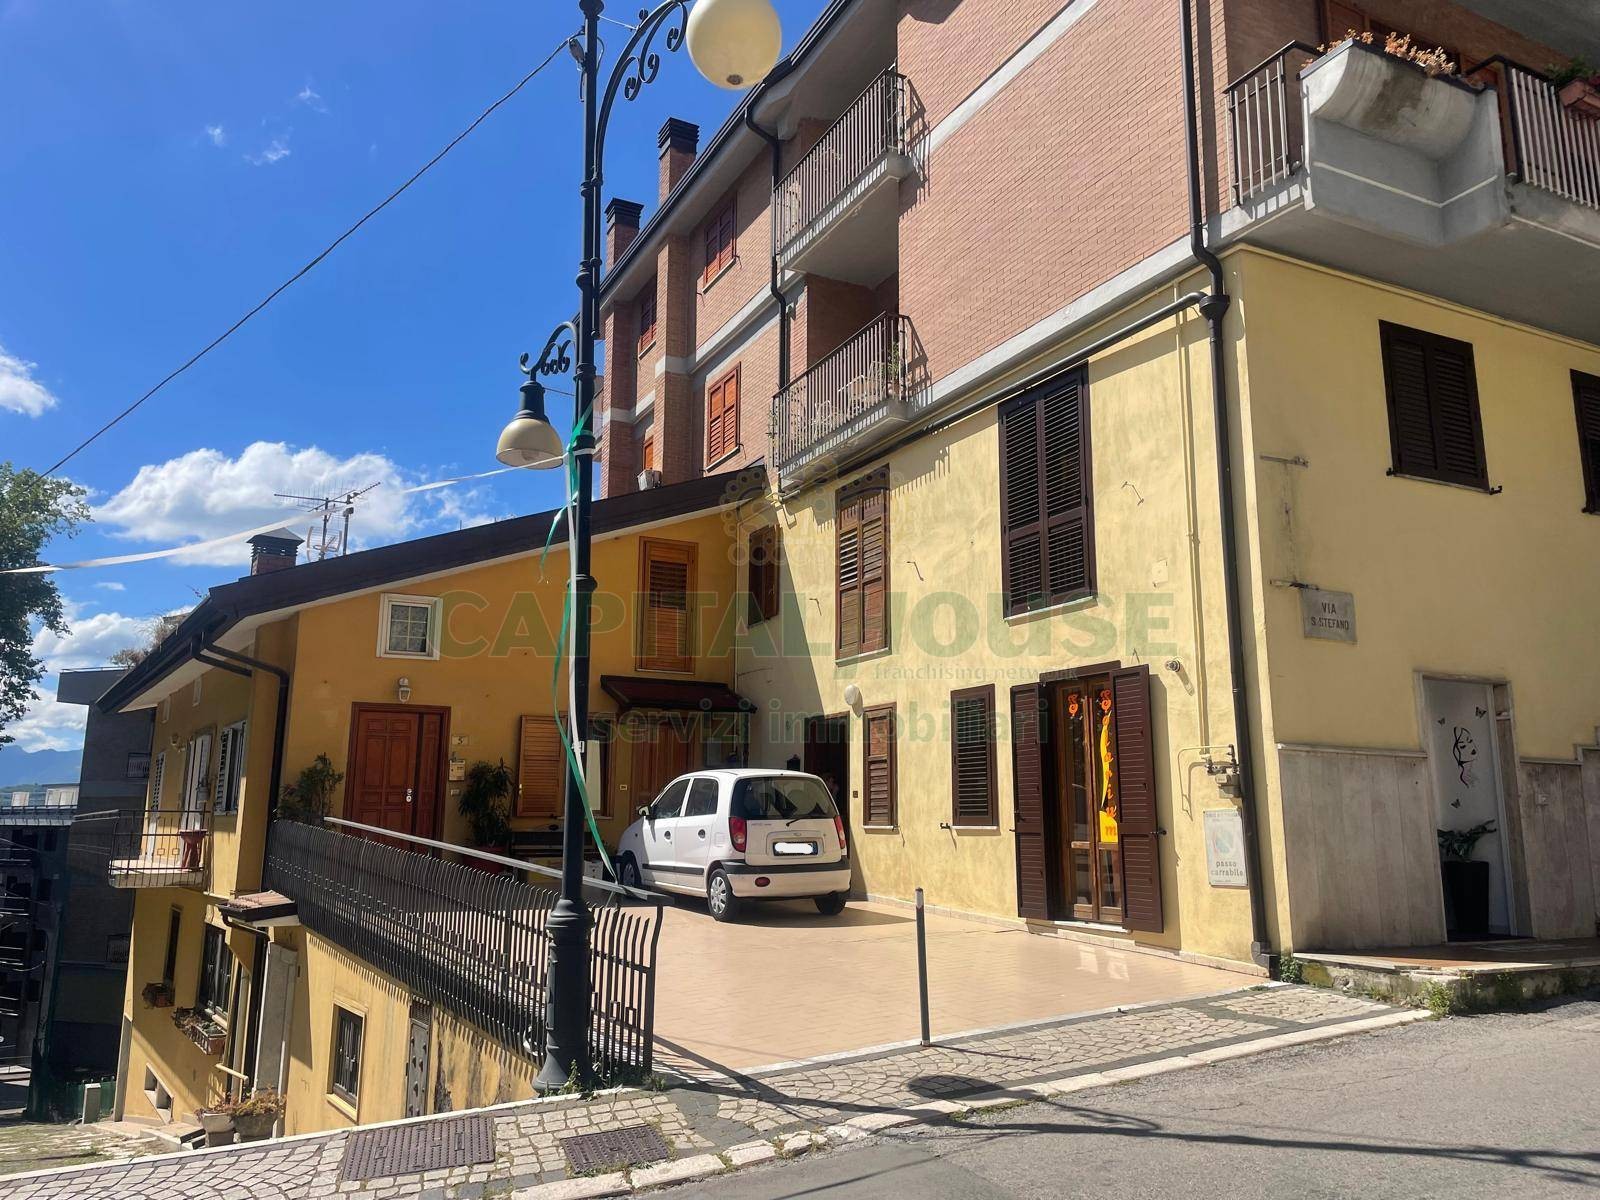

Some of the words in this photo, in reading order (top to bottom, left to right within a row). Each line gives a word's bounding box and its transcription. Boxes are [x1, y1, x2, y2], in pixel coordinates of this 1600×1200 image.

[1321, 602, 1337, 614] VIA
[1318, 617, 1349, 630] STEFANO
[1211, 868, 1243, 876] carrabile
